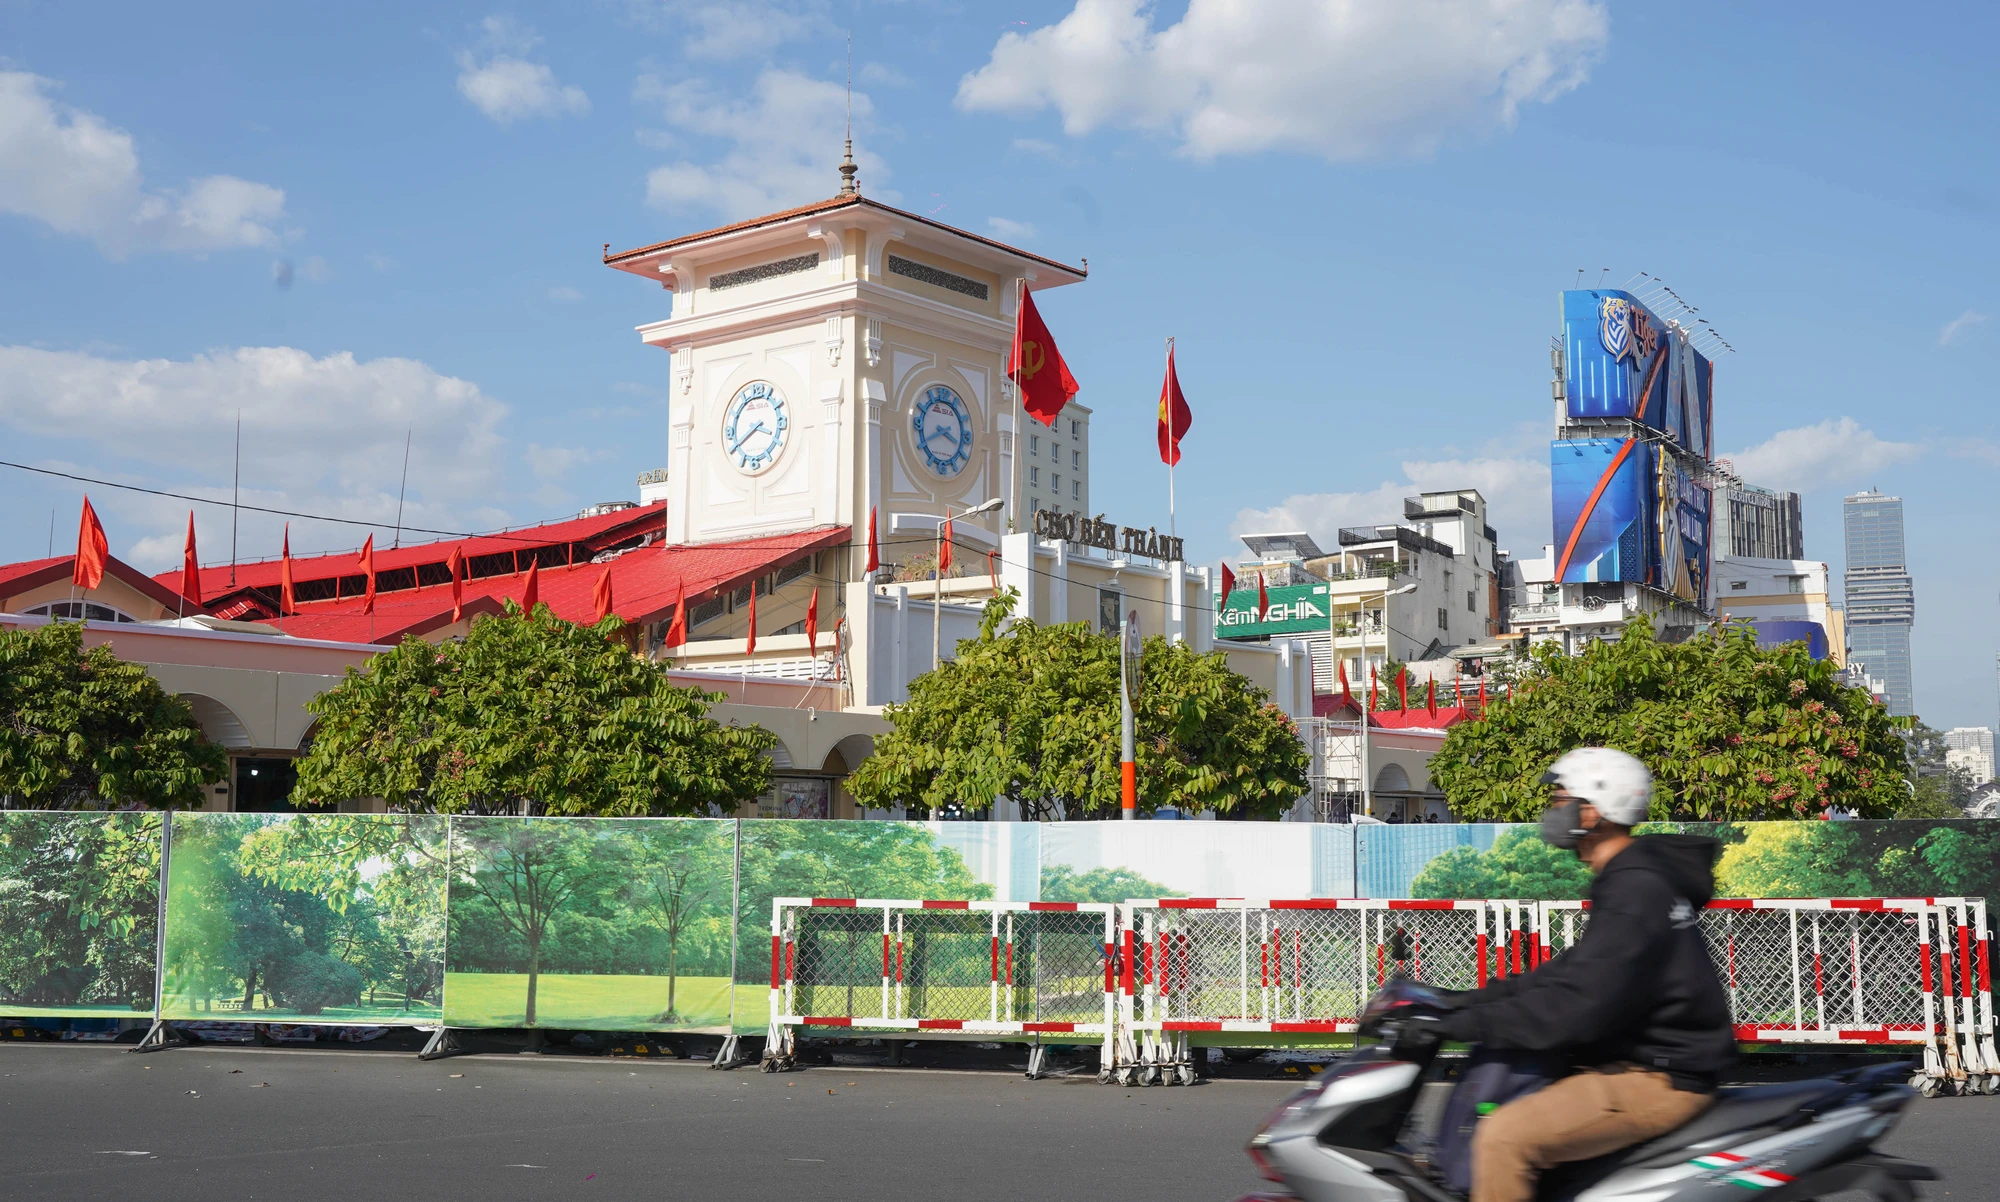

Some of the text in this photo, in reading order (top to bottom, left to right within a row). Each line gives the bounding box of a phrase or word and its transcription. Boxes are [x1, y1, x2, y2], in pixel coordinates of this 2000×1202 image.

[1630, 304, 1659, 358] Tiger
[1080, 512, 1117, 550] BẾN
[1121, 526, 1184, 561] THÀNH
